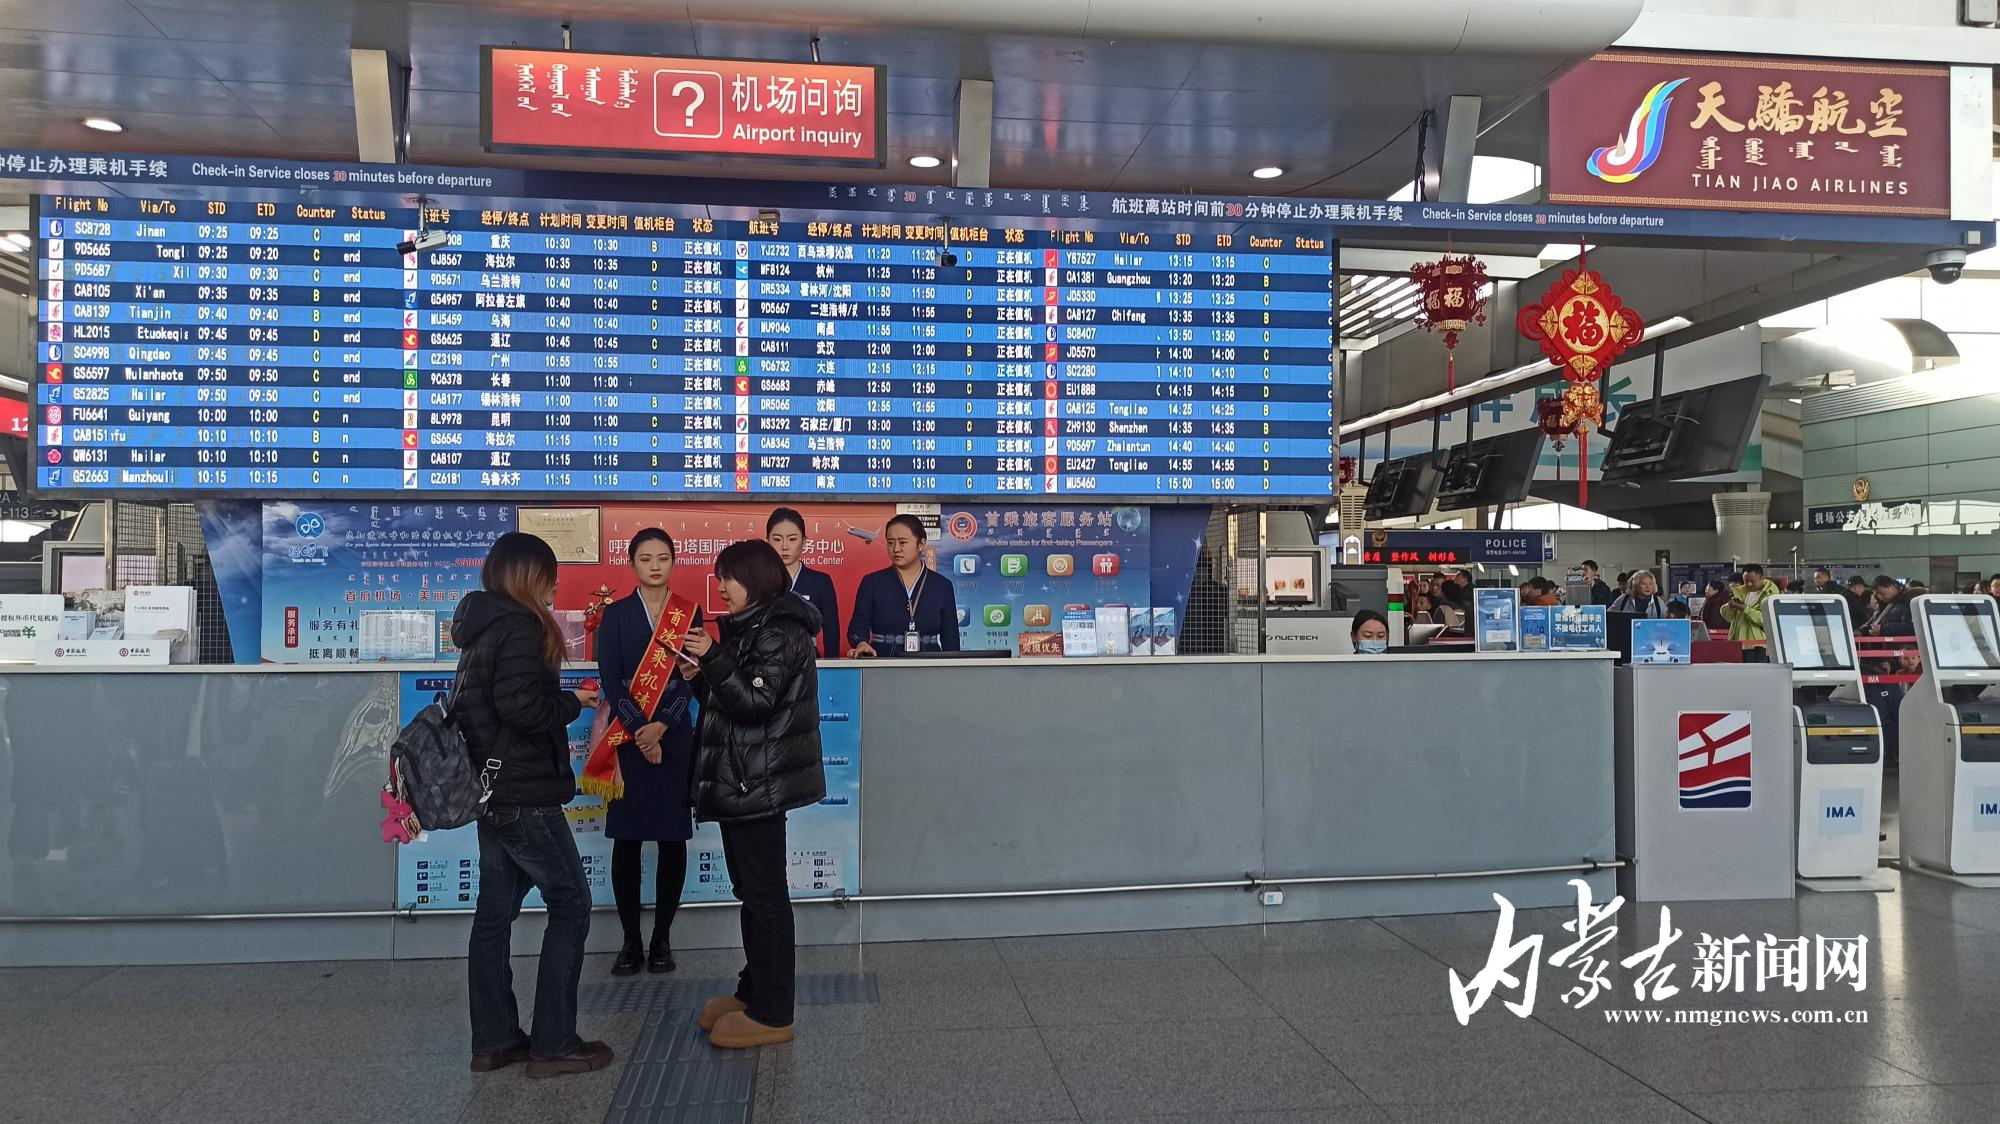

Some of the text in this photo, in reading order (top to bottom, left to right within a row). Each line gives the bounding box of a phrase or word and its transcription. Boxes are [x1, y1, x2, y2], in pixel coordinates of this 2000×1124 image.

[732, 73, 862, 118] 机场问询
[733, 123, 862, 148] Airport inquiry
[192, 163, 492, 188] Check-in Service closes 30 minutes before departure
[1692, 174, 1908, 194] TIAN JIAO AIRLINES
[56, 198, 91, 212] Flight
[141, 200, 176, 213] Via/To
[208, 202, 225, 214] STD
[258, 203, 275, 216] ETD
[297, 204, 335, 218] Counter
[352, 206, 385, 220] Status
[1111, 198, 1403, 222] 航班离站时间前30分钟停止办理乘机手续
[1422, 207, 1664, 227] Check-in Service closes 30 minutes before departure
[482, 210, 529, 226] 经停/终点
[540, 213, 581, 228] 计划时间
[586, 214, 627, 230] 变更时间
[634, 216, 674, 231] 值机柜台
[693, 218, 714, 232] 状态
[136, 224, 165, 237] Jinan
[199, 225, 227, 238] 09:25
[250, 227, 278, 240] 09:25
[344, 230, 360, 242] end
[747, 220, 1026, 242] 航班号 经停/终点 计划时间 变更时间 值机柜台 状态
[1050, 230, 1080, 243] Flight
[1120, 232, 1149, 244] Via/To
[1176, 234, 1190, 245] STD
[1217, 235, 1231, 246] ETD
[1250, 236, 1282, 248] Counter
[1296, 237, 1324, 248] Status
[1067, 271, 1235, 286] CA1381 Guangzhou 13:20 13:20
[74, 284, 110, 297] CA8105
[198, 286, 227, 299] 09:35
[250, 288, 278, 300] 09:35
[344, 290, 360, 302] end
[1444, 287, 1464, 308] 福
[1563, 300, 1604, 347] 福
[761, 341, 1032, 358] CA8111 武汉 12:00 12:00 正在值机
[491, 352, 510, 367] 广州
[546, 355, 570, 367] 10:55
[594, 356, 618, 368] 10:55
[684, 357, 722, 372] 正在值机
[761, 360, 1032, 377] 9C6732 大连 12:15 12:15 正在值机
[128, 408, 170, 423] Guiyang
[198, 409, 226, 422] 10:00
[250, 409, 278, 422] 10:00
[492, 413, 510, 426] 昆明
[546, 414, 570, 426] 11:00
[594, 415, 618, 426] 11:00
[684, 416, 722, 430] 正在值机
[1066, 421, 1234, 434] ZH9130 Shenzhen 14:35 14:35
[985, 510, 1113, 528] 首乘旅客服务站
[1009, 539, 1030, 547] station
[1031, 539, 1040, 547] for
[1486, 539, 1527, 548] POLICE
[817, 555, 844, 566] Center
[286, 609, 297, 645] 服务承诺
[309, 647, 359, 660] 抵离顺畅
[1022, 643, 1060, 653] 劳模优先
[1826, 806, 1856, 818] IMA
[1980, 803, 2000, 815] IM
